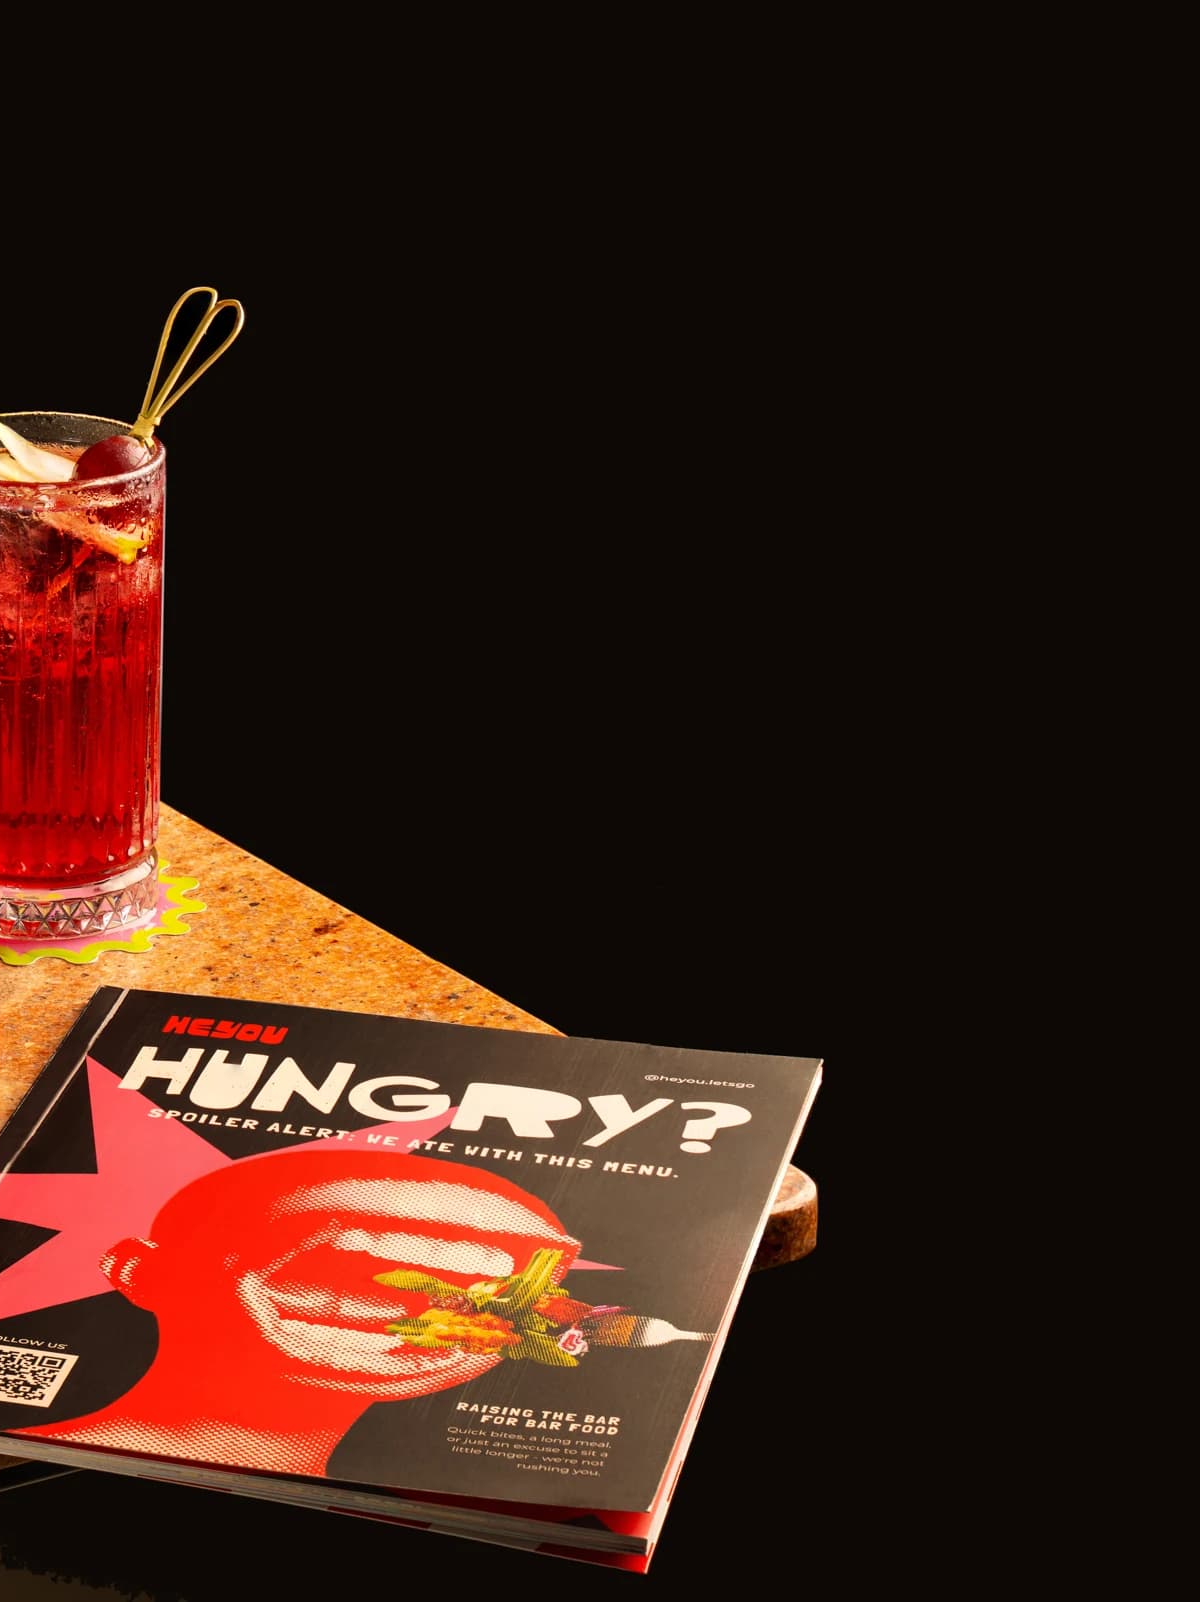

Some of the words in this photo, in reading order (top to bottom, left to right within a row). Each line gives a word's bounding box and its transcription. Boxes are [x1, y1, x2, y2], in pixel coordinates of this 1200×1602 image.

[162, 1015, 288, 1045] HEYOU
[644, 1074, 755, 1089] @heyou.letsgo
[117, 1045, 752, 1154] HUNGRY?
[147, 1108, 259, 1130] SPOILER
[266, 1122, 355, 1142] ALERT:
[367, 1134, 399, 1146] WE
[406, 1139, 454, 1153] ATE
[465, 1145, 522, 1162] WITH
[534, 1153, 594, 1169] THIS
[603, 1161, 679, 1179] MENU.
[47, 1342, 68, 1350] US
[456, 1402, 534, 1418] RAISING
[541, 1410, 577, 1422] THE
[584, 1415, 621, 1426] BAR
[479, 1415, 519, 1426] FOR
[525, 1419, 562, 1431] BAR
[568, 1424, 619, 1436] FOOD
[447, 1426, 488, 1437] Quick
[490, 1430, 526, 1442] bites,
[540, 1435, 572, 1447] long
[451, 1446, 483, 1455] little
[485, 1448, 531, 1461] longer
[542, 1456, 579, 1465] we're
[581, 1459, 604, 1467] not
[462, 1438, 489, 1447] just
[492, 1441, 510, 1449] an
[513, 1444, 561, 1454] excuse
[564, 1447, 578, 1455] to
[580, 1449, 597, 1458] sit
[516, 1463, 571, 1475] rushing
